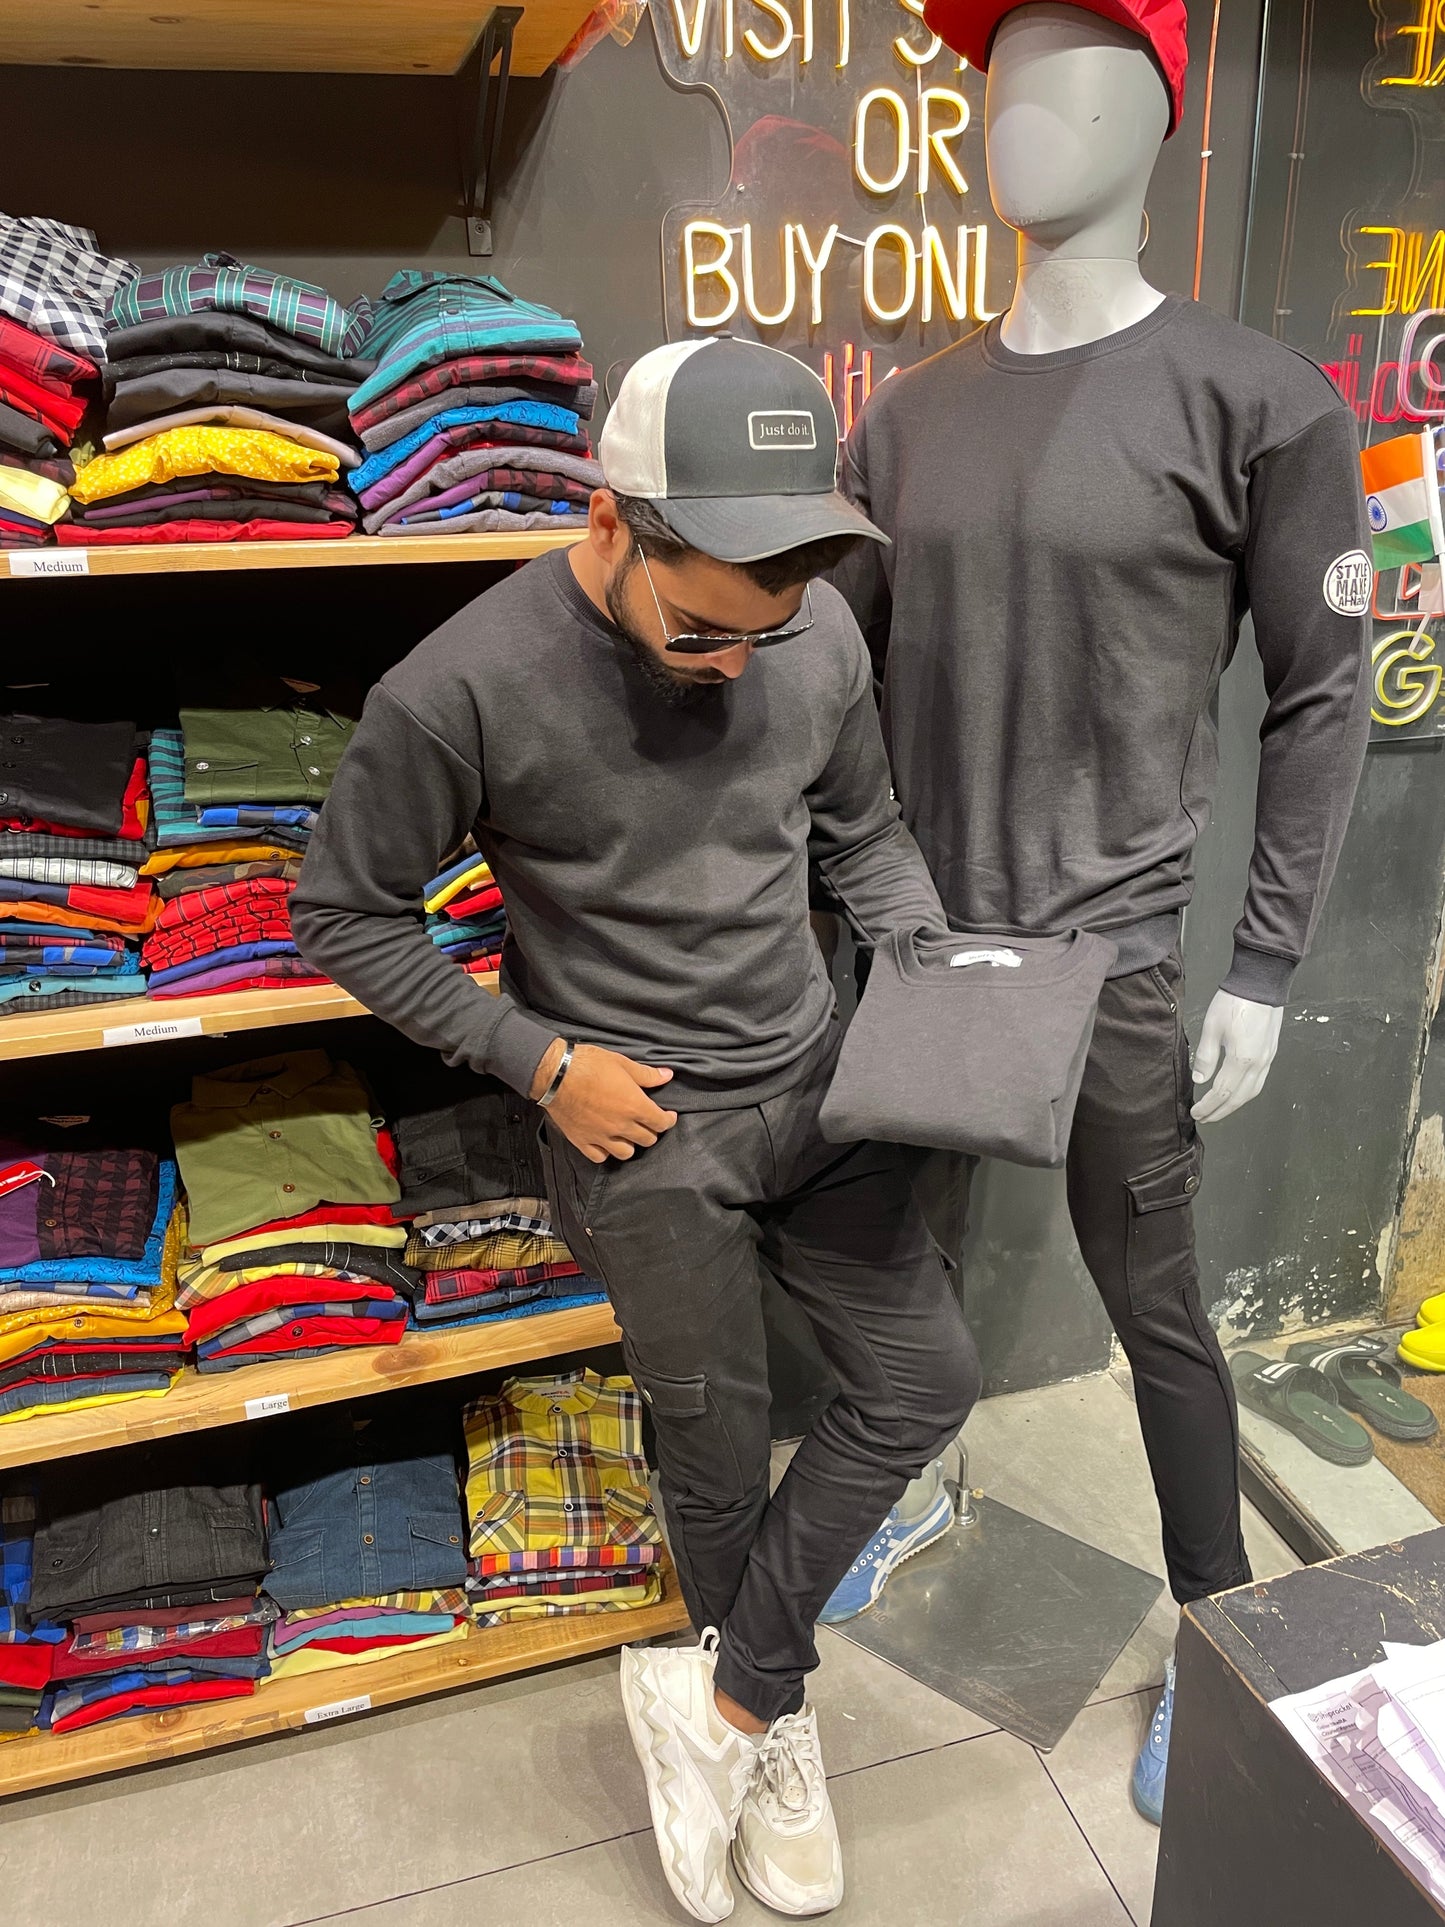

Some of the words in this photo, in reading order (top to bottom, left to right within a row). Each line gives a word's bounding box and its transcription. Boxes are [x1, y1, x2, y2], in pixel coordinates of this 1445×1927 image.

[855, 87, 970, 195] OR
[684, 221, 838, 326] BUY
[863, 223, 1001, 324] ONL
[760, 423, 785, 439] Just
[787, 422, 800, 436] do
[33, 560, 84, 572] Medium
[1336, 563, 1367, 580] STYLE
[134, 1024, 178, 1037] Medium
[261, 1400, 288, 1410] Large
[316, 1709, 340, 1719] Extra
[341, 1703, 366, 1714] Large
